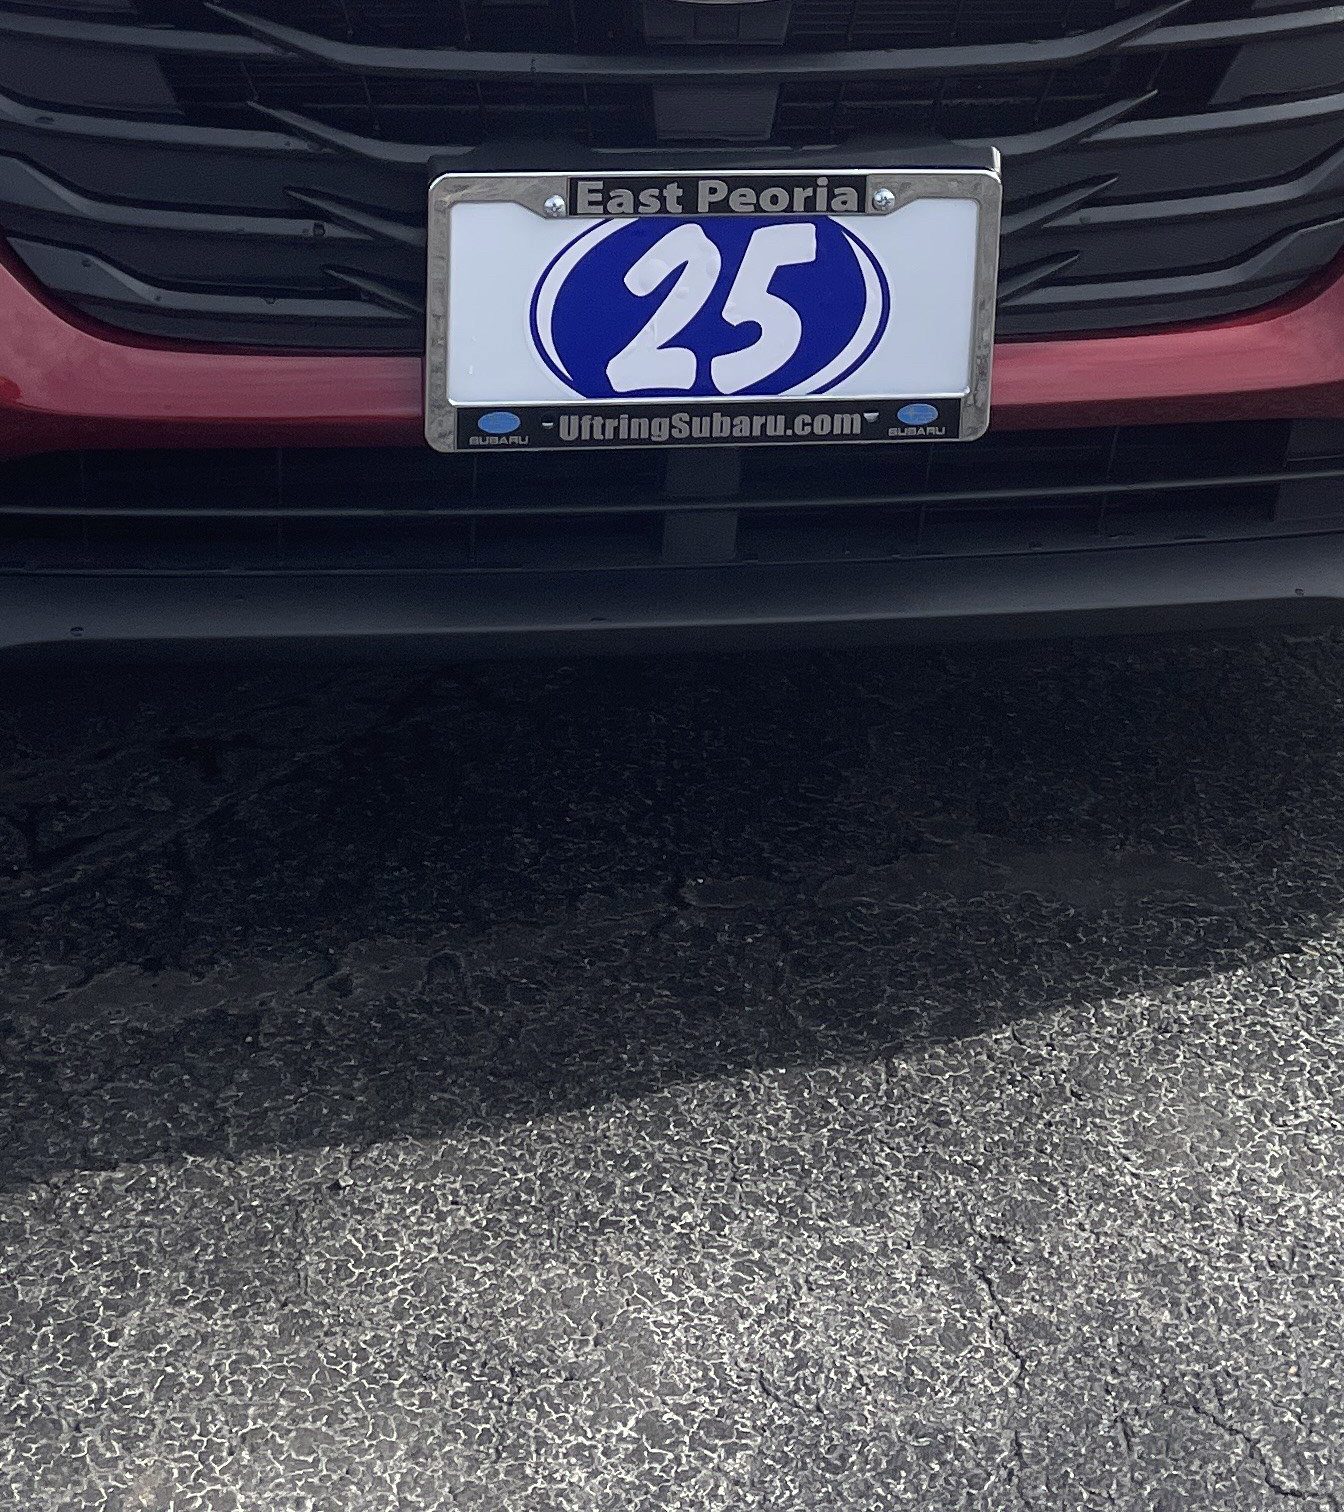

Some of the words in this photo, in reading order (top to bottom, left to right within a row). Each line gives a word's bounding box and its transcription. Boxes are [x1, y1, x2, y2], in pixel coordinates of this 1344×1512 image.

[576, 181, 684, 215] East
[696, 176, 859, 213] Peoria
[605, 222, 818, 396] 25
[469, 435, 529, 445] SUBARU
[559, 409, 862, 443] UftringSubaru.com
[888, 426, 946, 437] SUBARU
